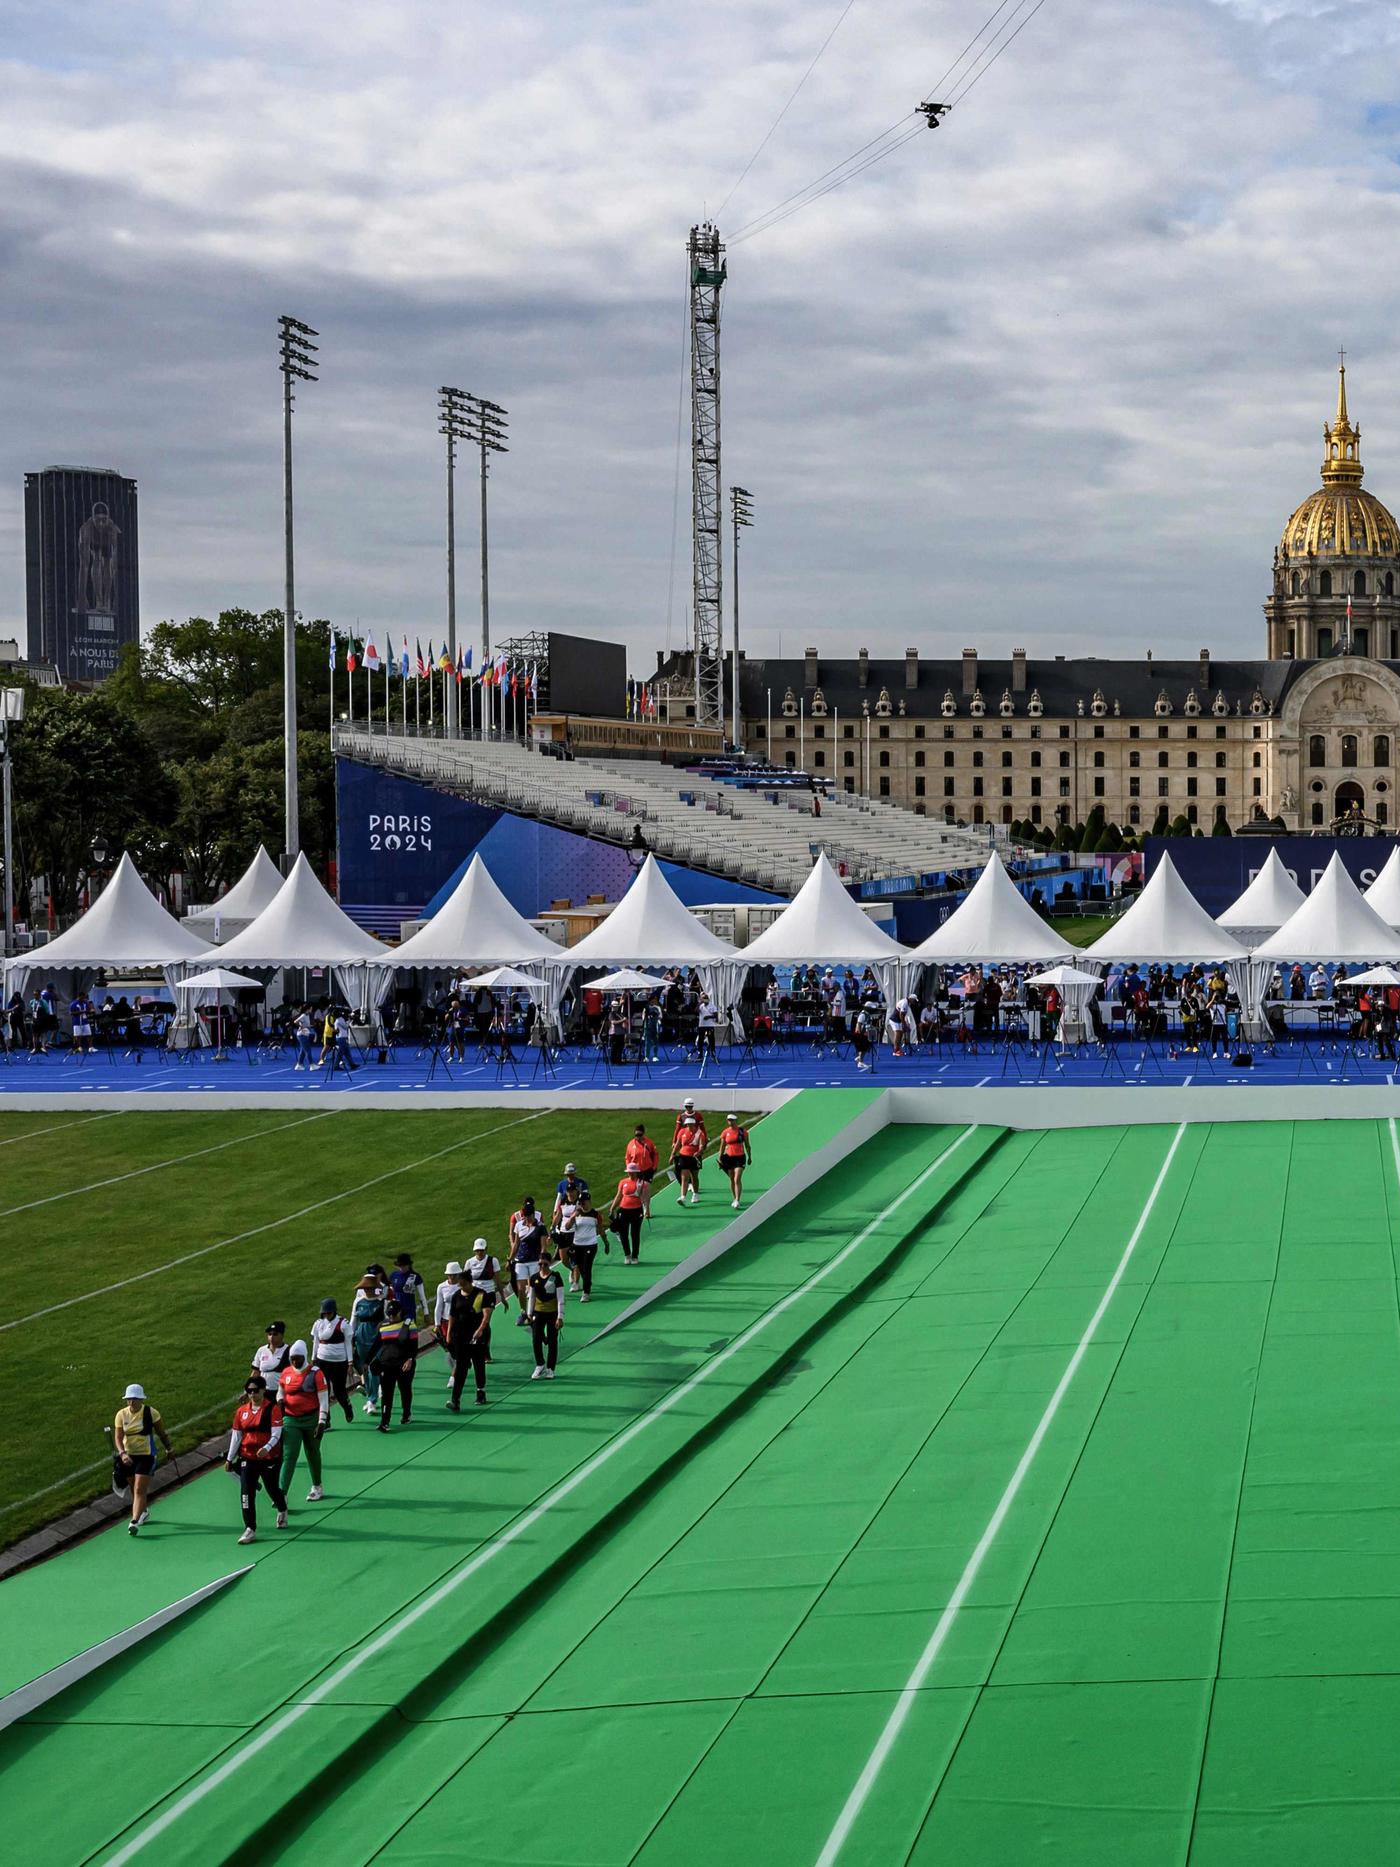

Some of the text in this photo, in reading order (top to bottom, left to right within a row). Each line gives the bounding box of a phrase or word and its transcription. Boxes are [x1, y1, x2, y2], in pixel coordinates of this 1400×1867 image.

[79, 647, 108, 658] NOUS
[87, 659, 114, 669] PARIS
[369, 834, 432, 852] 2024
